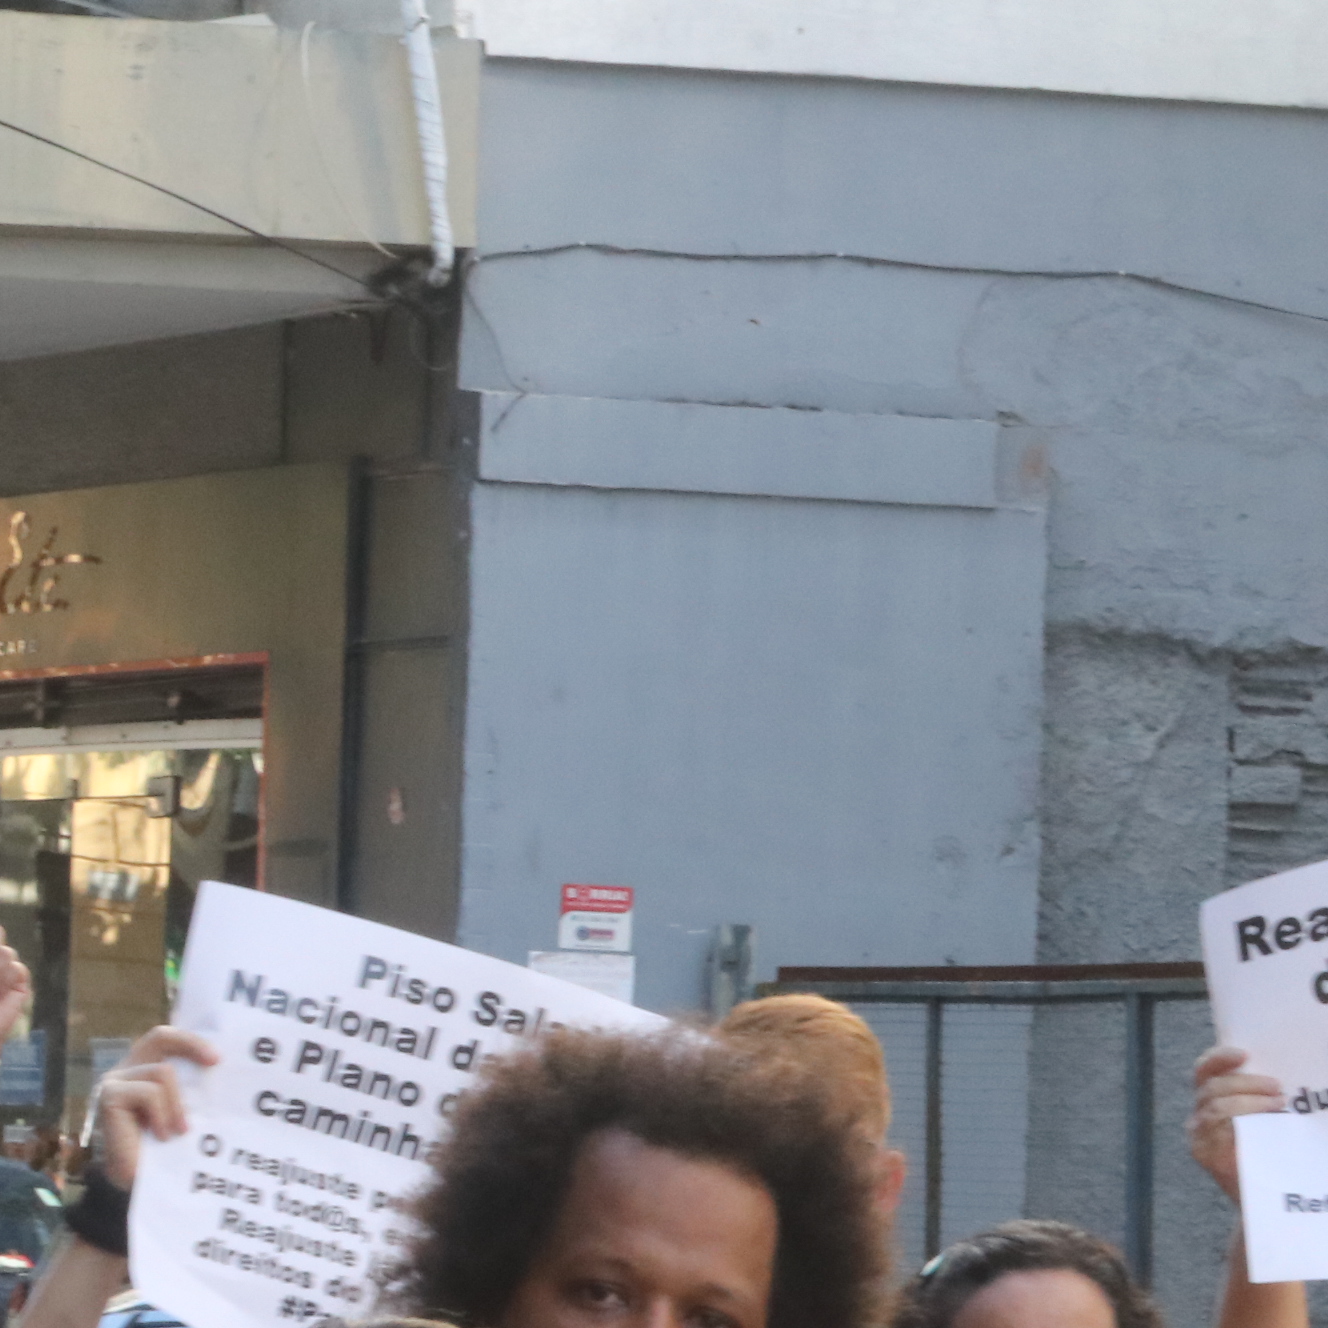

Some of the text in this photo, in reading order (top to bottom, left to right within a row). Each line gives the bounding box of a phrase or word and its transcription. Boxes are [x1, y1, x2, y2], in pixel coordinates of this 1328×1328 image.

[1236, 907, 1328, 962] Rea
[227, 969, 439, 1060] Nacional
[357, 955, 459, 1014] Piso
[252, 1036, 279, 1064] e
[294, 1040, 422, 1107] Plano
[254, 1089, 424, 1161] caminh
[191, 1170, 263, 1205] para
[199, 1133, 224, 1158] O
[230, 1148, 362, 1201] reajuste
[194, 1236, 314, 1289] direitos
[219, 1207, 358, 1268] Reajuste
